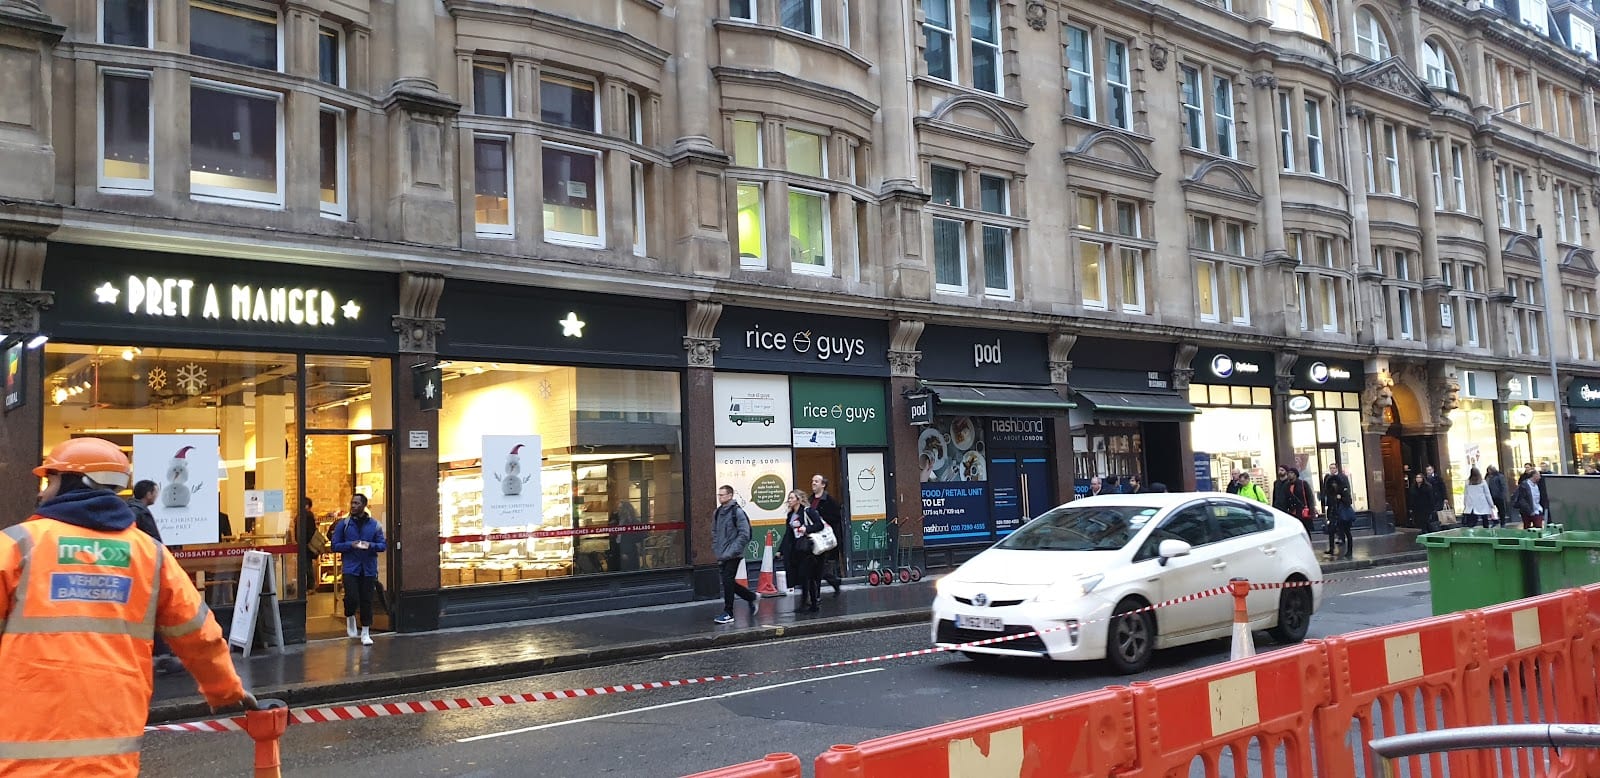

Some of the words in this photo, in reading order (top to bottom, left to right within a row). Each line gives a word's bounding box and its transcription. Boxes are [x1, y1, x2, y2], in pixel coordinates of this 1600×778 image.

[128, 275, 194, 315] PRET
[203, 282, 220, 319] A
[231, 284, 336, 325] MANGER
[746, 324, 787, 350] rice
[816, 335, 865, 361] guys
[974, 338, 1001, 367] pod
[803, 402, 828, 418] rice
[845, 406, 876, 422] guys
[911, 402, 927, 419] pod
[991, 416, 1043, 432] nashbond
[724, 456, 756, 467] coming
[921, 489, 941, 498] FOOD
[945, 488, 968, 497] RETAIL
[968, 488, 982, 496] UNIT
[922, 499, 932, 507] TO
[932, 498, 945, 507] LET
[595, 526, 626, 534] CAPPUCCINO
[924, 523, 949, 533] nashbond
[173, 550, 216, 559] ROISSANTS
[68, 575, 120, 588] VEHICLE
[58, 587, 124, 601] BANKSMAN
